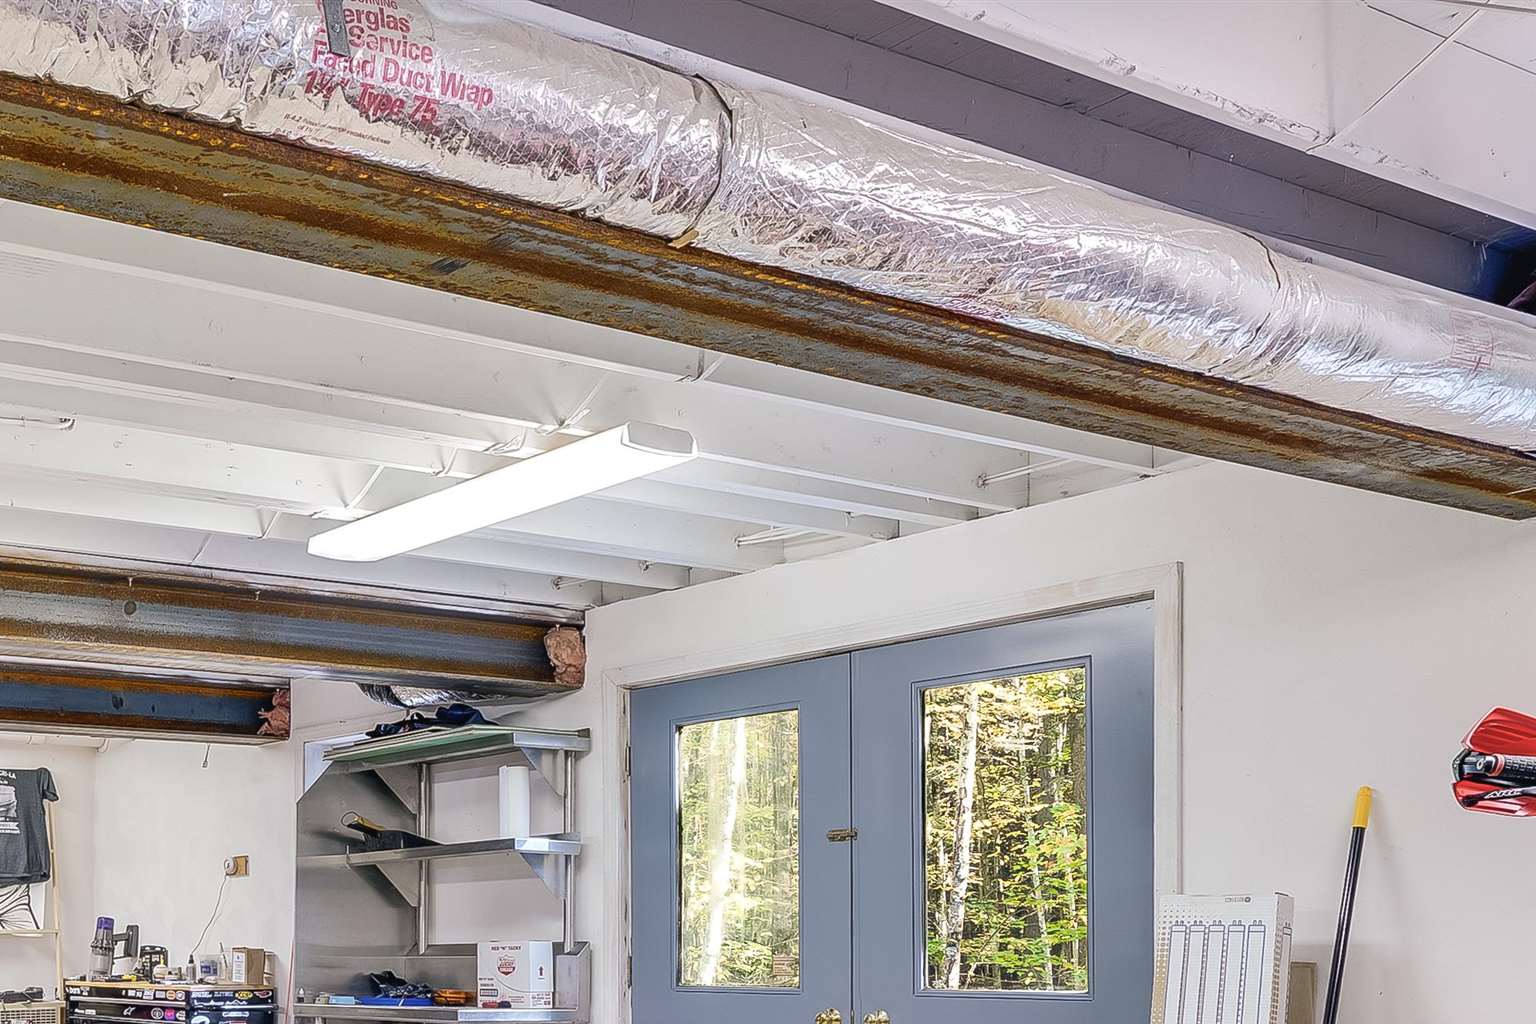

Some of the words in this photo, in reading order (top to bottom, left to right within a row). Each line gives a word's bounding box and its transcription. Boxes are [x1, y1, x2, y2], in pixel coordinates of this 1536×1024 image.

[348, 25, 433, 64] Service
[358, 82, 407, 118] Type
[410, 95, 439, 123] 75
[382, 57, 435, 93] Duct
[440, 68, 494, 111] Wrap
